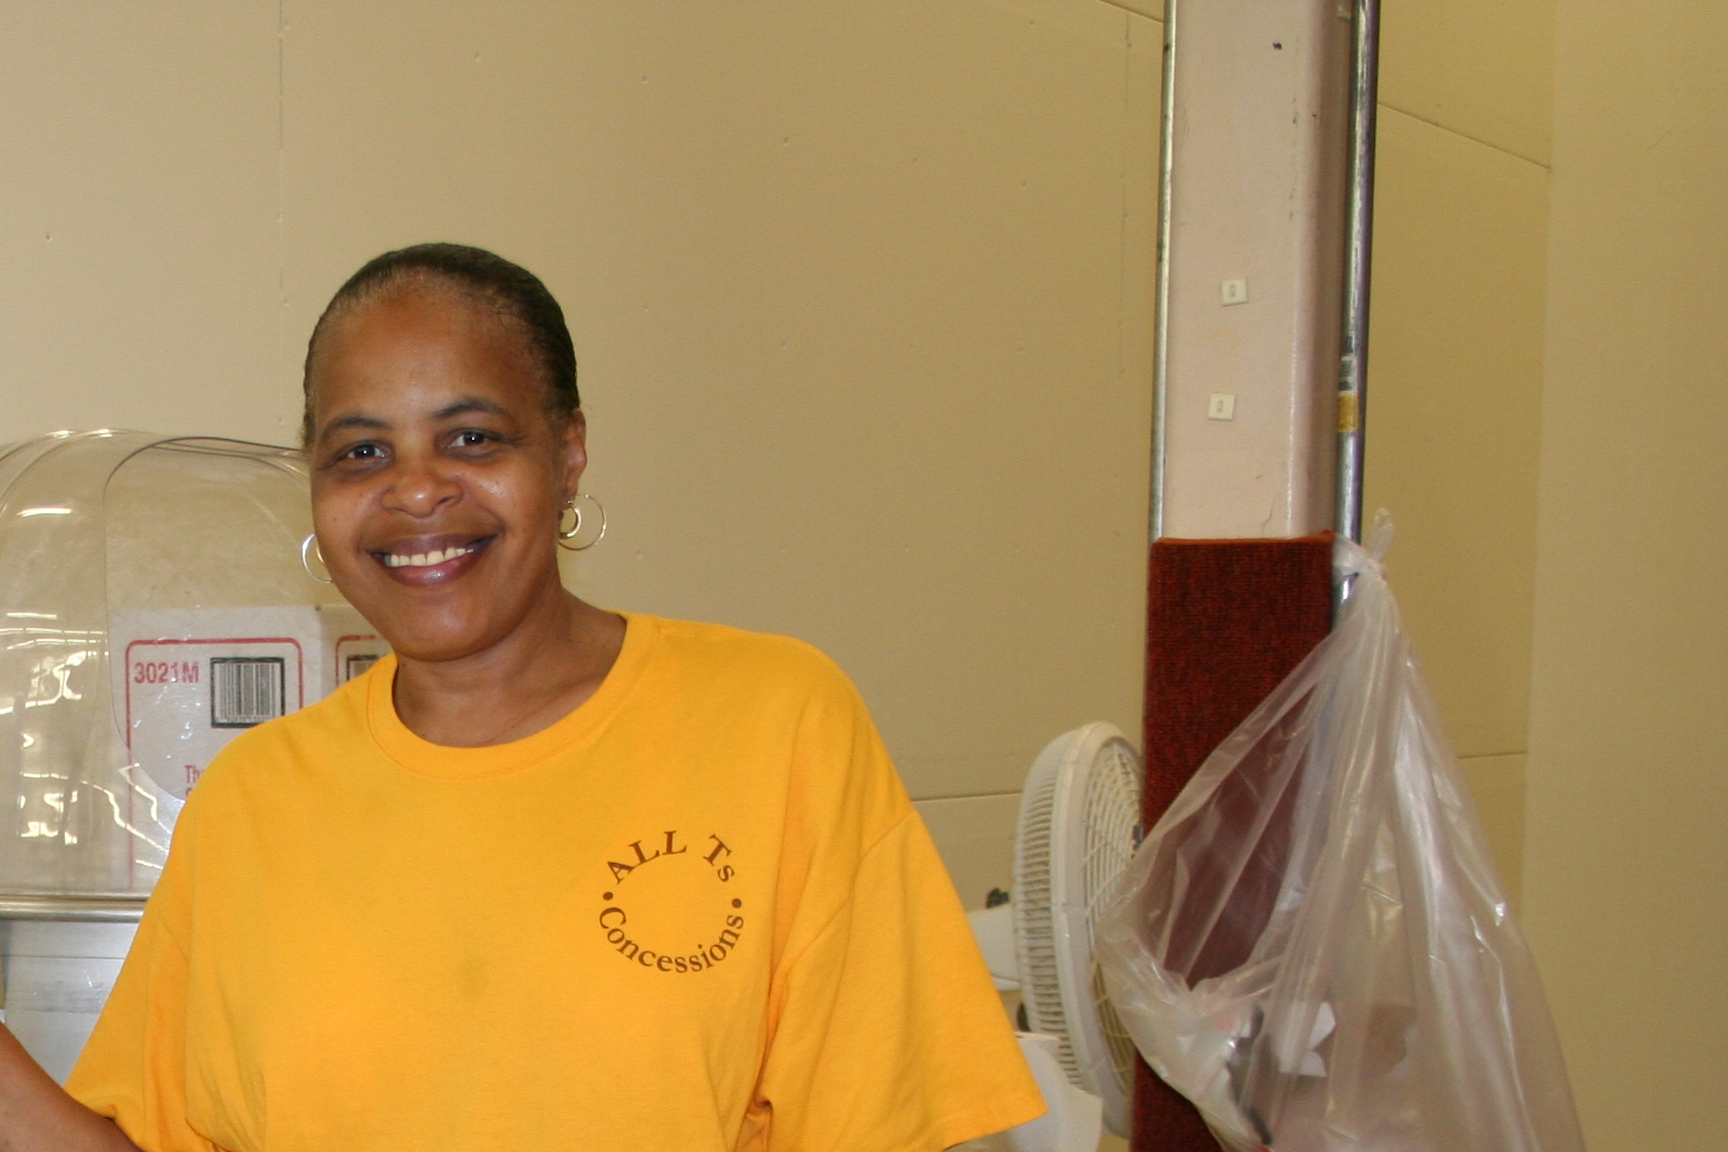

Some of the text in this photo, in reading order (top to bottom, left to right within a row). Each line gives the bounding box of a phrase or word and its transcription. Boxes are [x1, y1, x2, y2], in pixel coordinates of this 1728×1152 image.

[134, 661, 200, 684] 3021M
[607, 830, 735, 885] ALL Ts
[599, 907, 744, 973] Concessions
